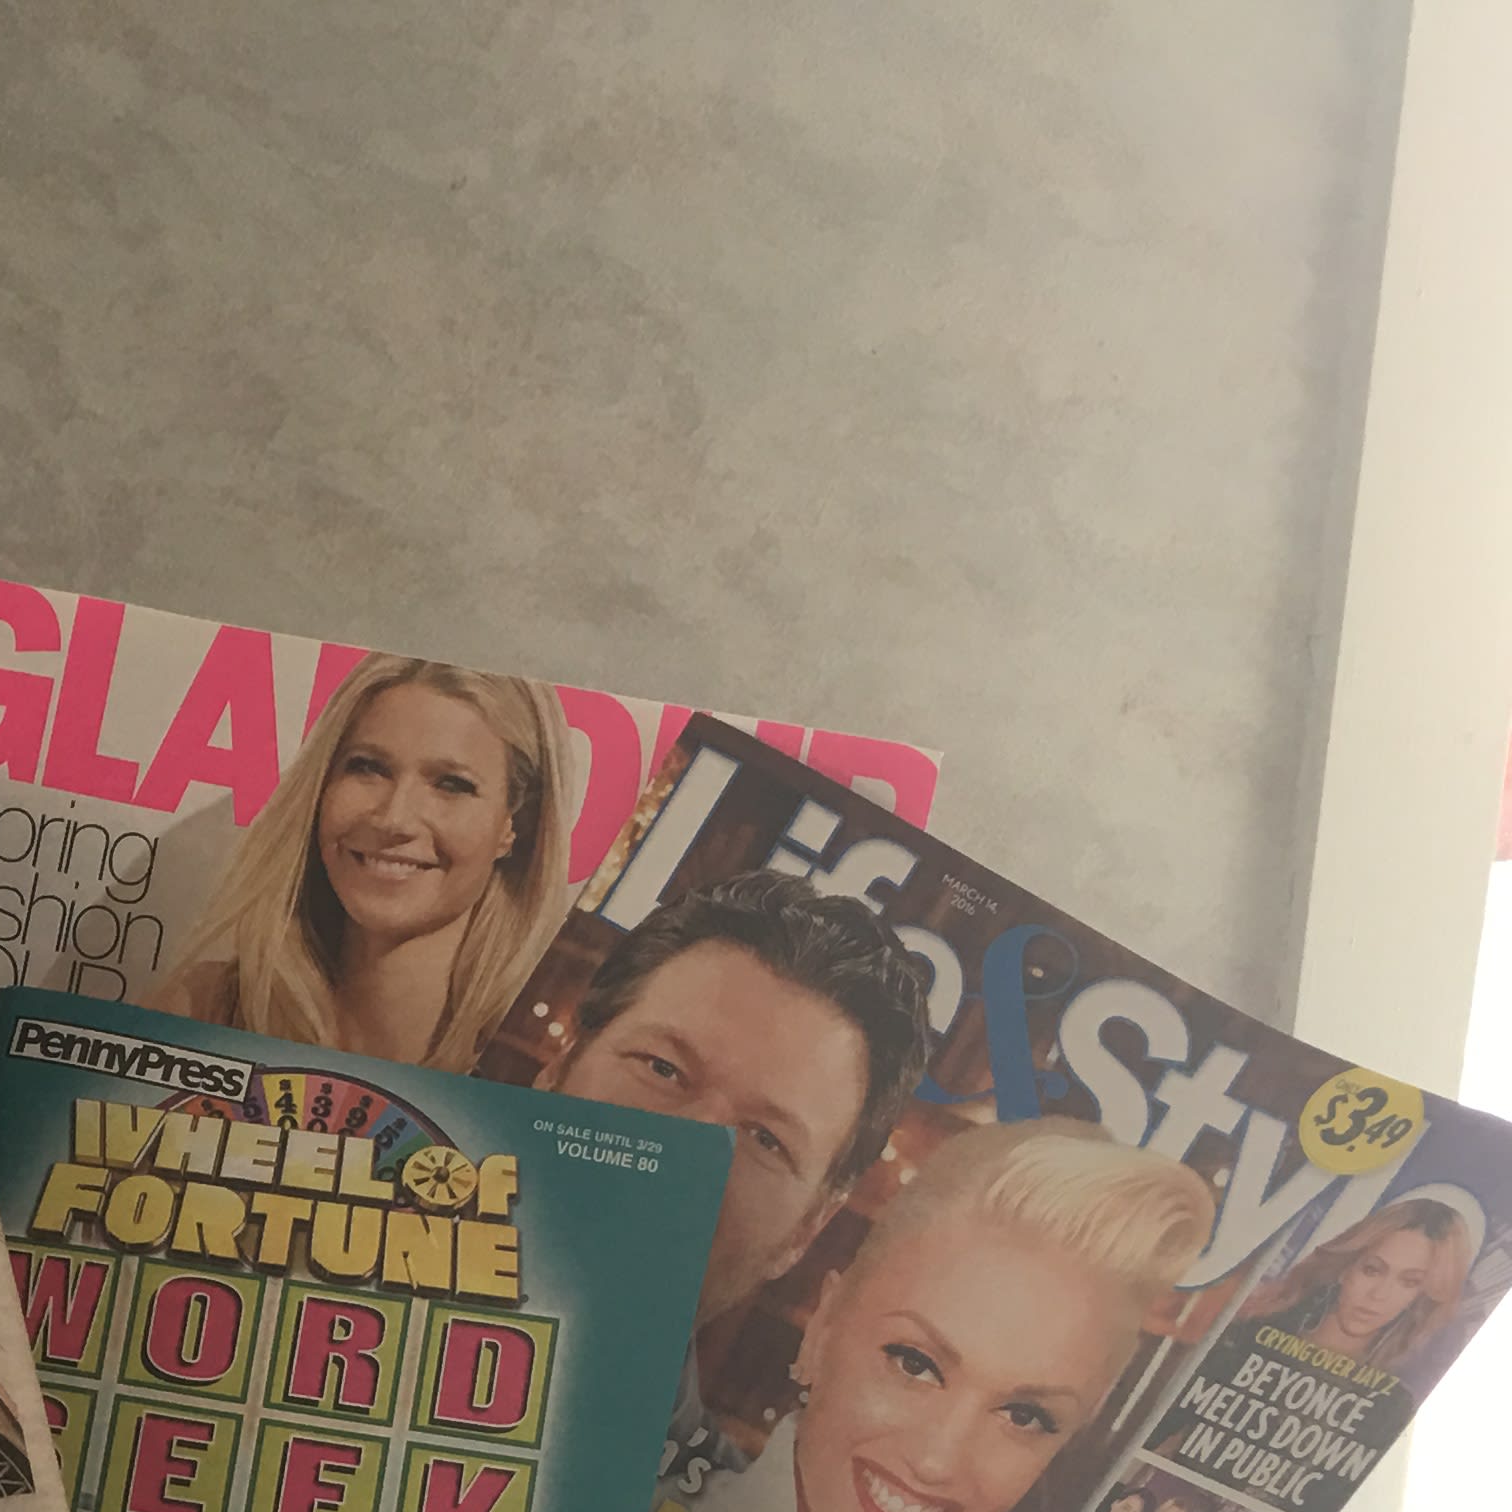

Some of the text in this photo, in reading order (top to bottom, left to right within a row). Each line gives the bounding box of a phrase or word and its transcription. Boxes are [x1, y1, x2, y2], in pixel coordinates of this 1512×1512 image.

[941, 873, 986, 905] MARCH
[950, 894, 976, 916] 2016
[13, 1021, 245, 1099] PennyPress
[73, 1098, 396, 1201] WHEEL
[533, 1119, 554, 1133] ON
[556, 1123, 592, 1141] SALE
[594, 1130, 633, 1149] UNTIL
[1314, 1087, 1414, 1153] $3.49
[557, 1140, 659, 1174] VOLUME 80
[30, 1161, 521, 1305] FORTUNE
[8, 1248, 538, 1435] WORD
[1255, 1325, 1314, 1360] CRYING
[1310, 1346, 1357, 1377] OVER
[1352, 1364, 1384, 1391] JAY
[1179, 1375, 1379, 1483] MELTS DOWN
[1179, 1422, 1324, 1507] IN PUBLIC
